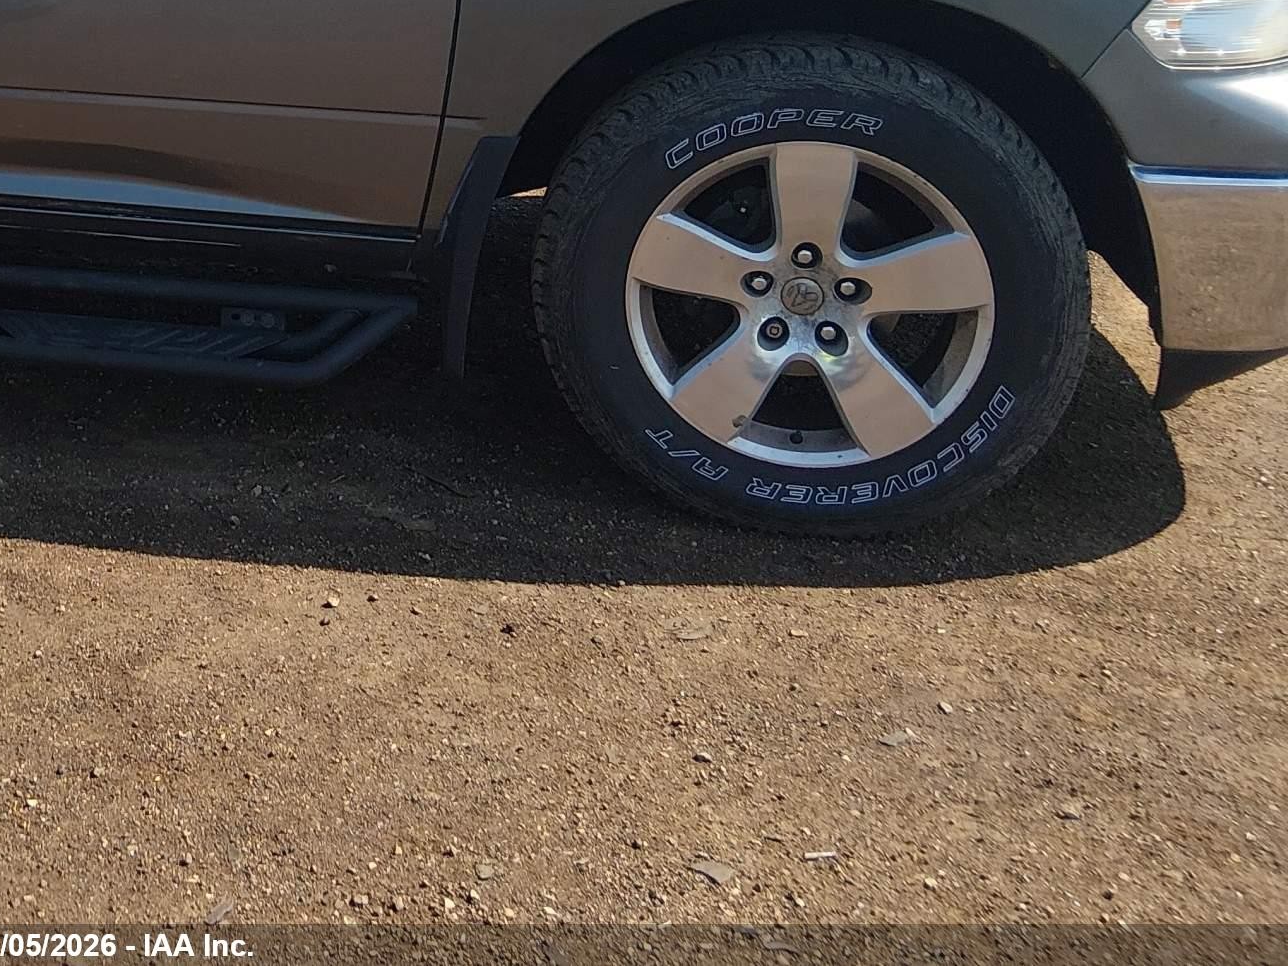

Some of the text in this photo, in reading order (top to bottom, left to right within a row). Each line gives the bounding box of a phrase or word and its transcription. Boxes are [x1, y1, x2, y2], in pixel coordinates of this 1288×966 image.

[665, 107, 883, 170] COOPER
[645, 385, 1016, 505] DISCOVERER A/T
